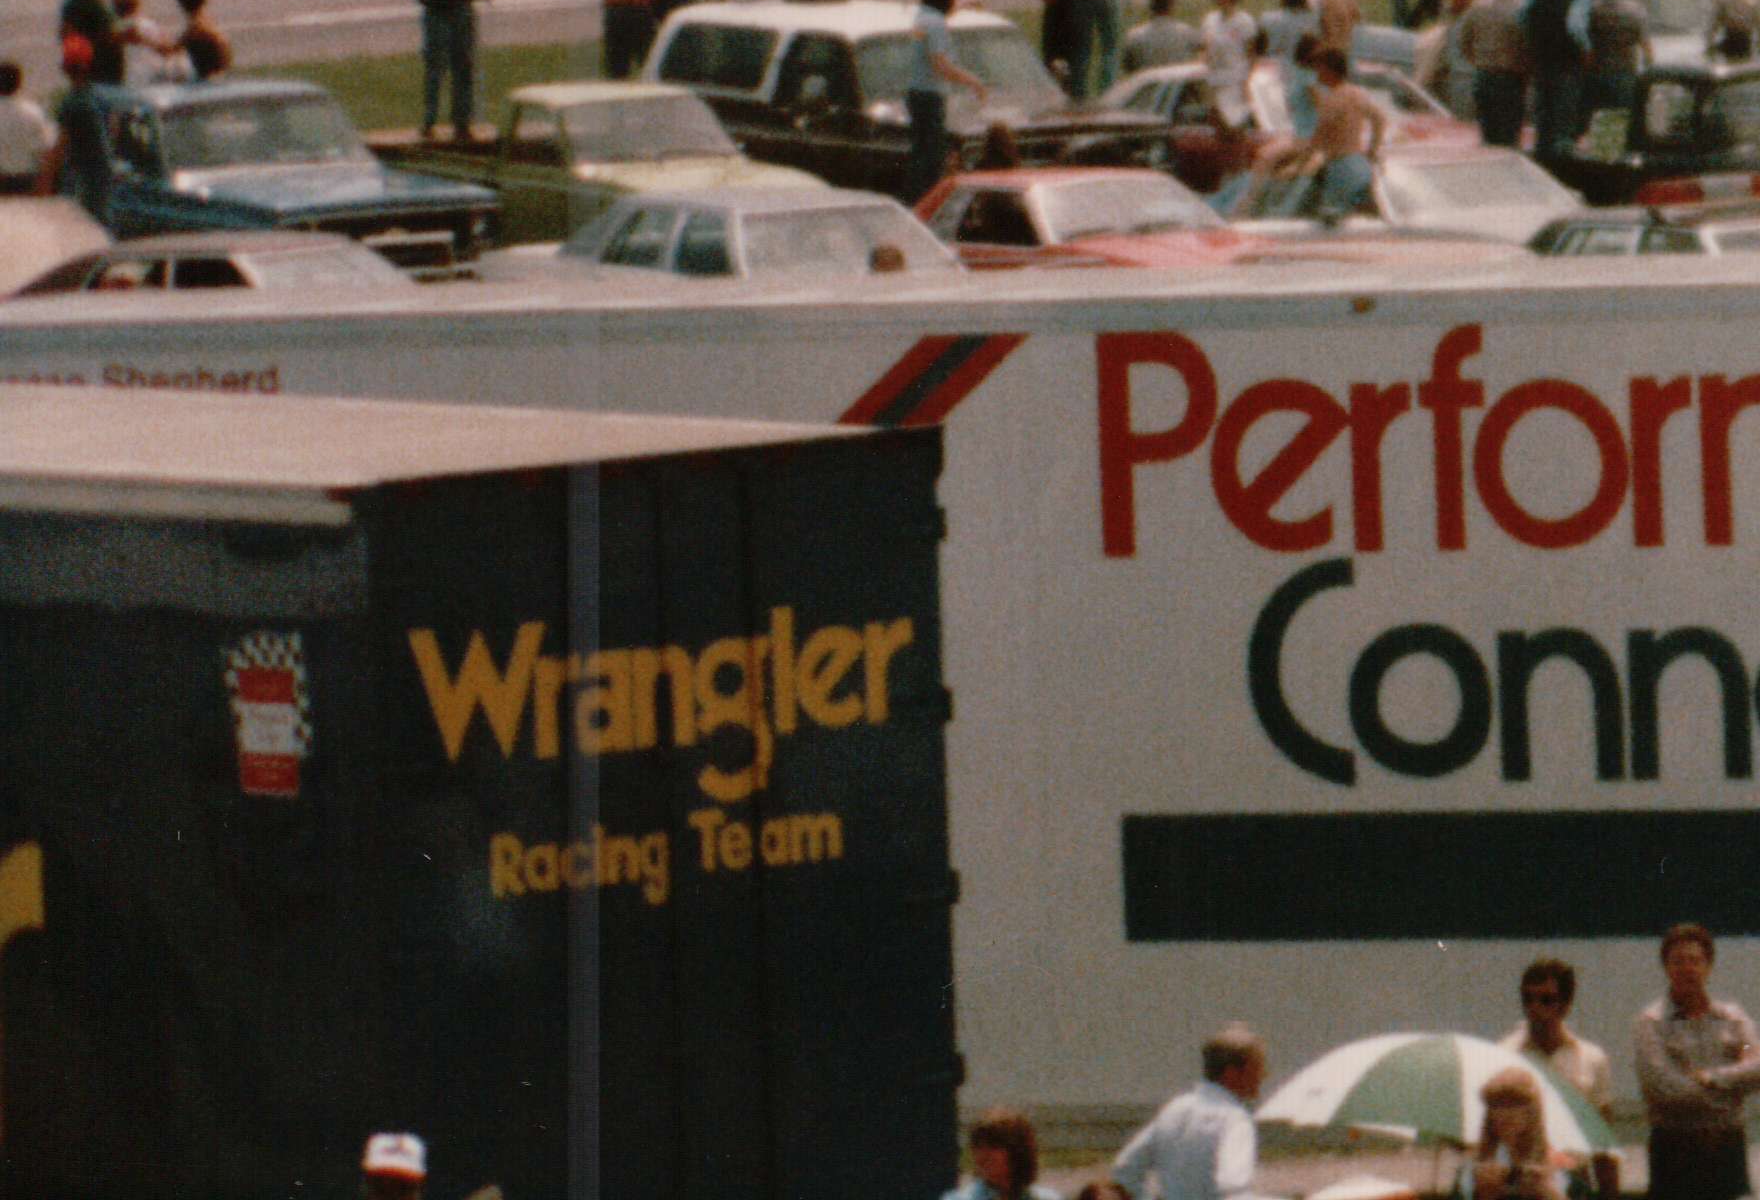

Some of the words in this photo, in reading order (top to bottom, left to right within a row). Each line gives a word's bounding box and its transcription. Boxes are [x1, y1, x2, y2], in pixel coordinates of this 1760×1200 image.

[407, 605, 914, 803] Wrangler
[489, 822, 672, 907] Racing
[687, 806, 845, 873] Team
